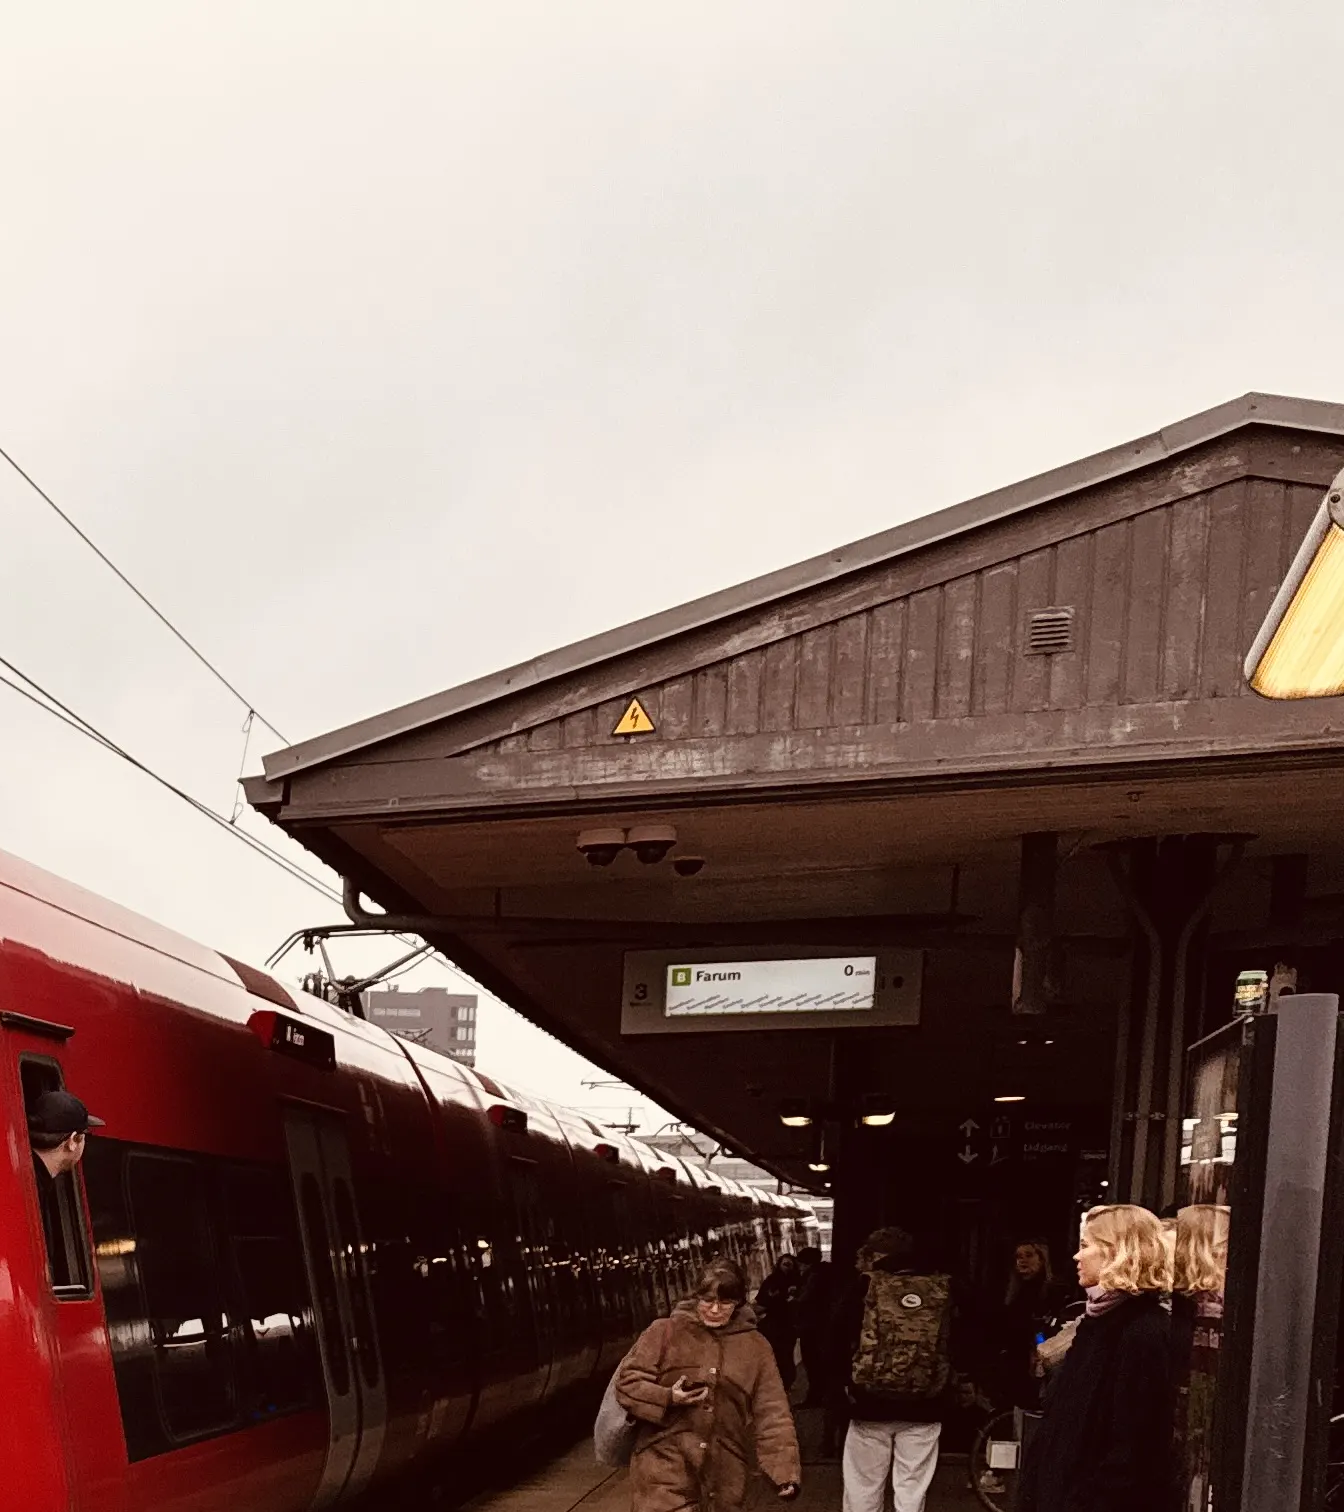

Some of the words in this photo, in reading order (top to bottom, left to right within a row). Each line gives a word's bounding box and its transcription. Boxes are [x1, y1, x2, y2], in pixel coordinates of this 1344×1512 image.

[696, 970, 742, 982] Farum
[844, 964, 854, 976] 0
[634, 982, 648, 1000] 3
